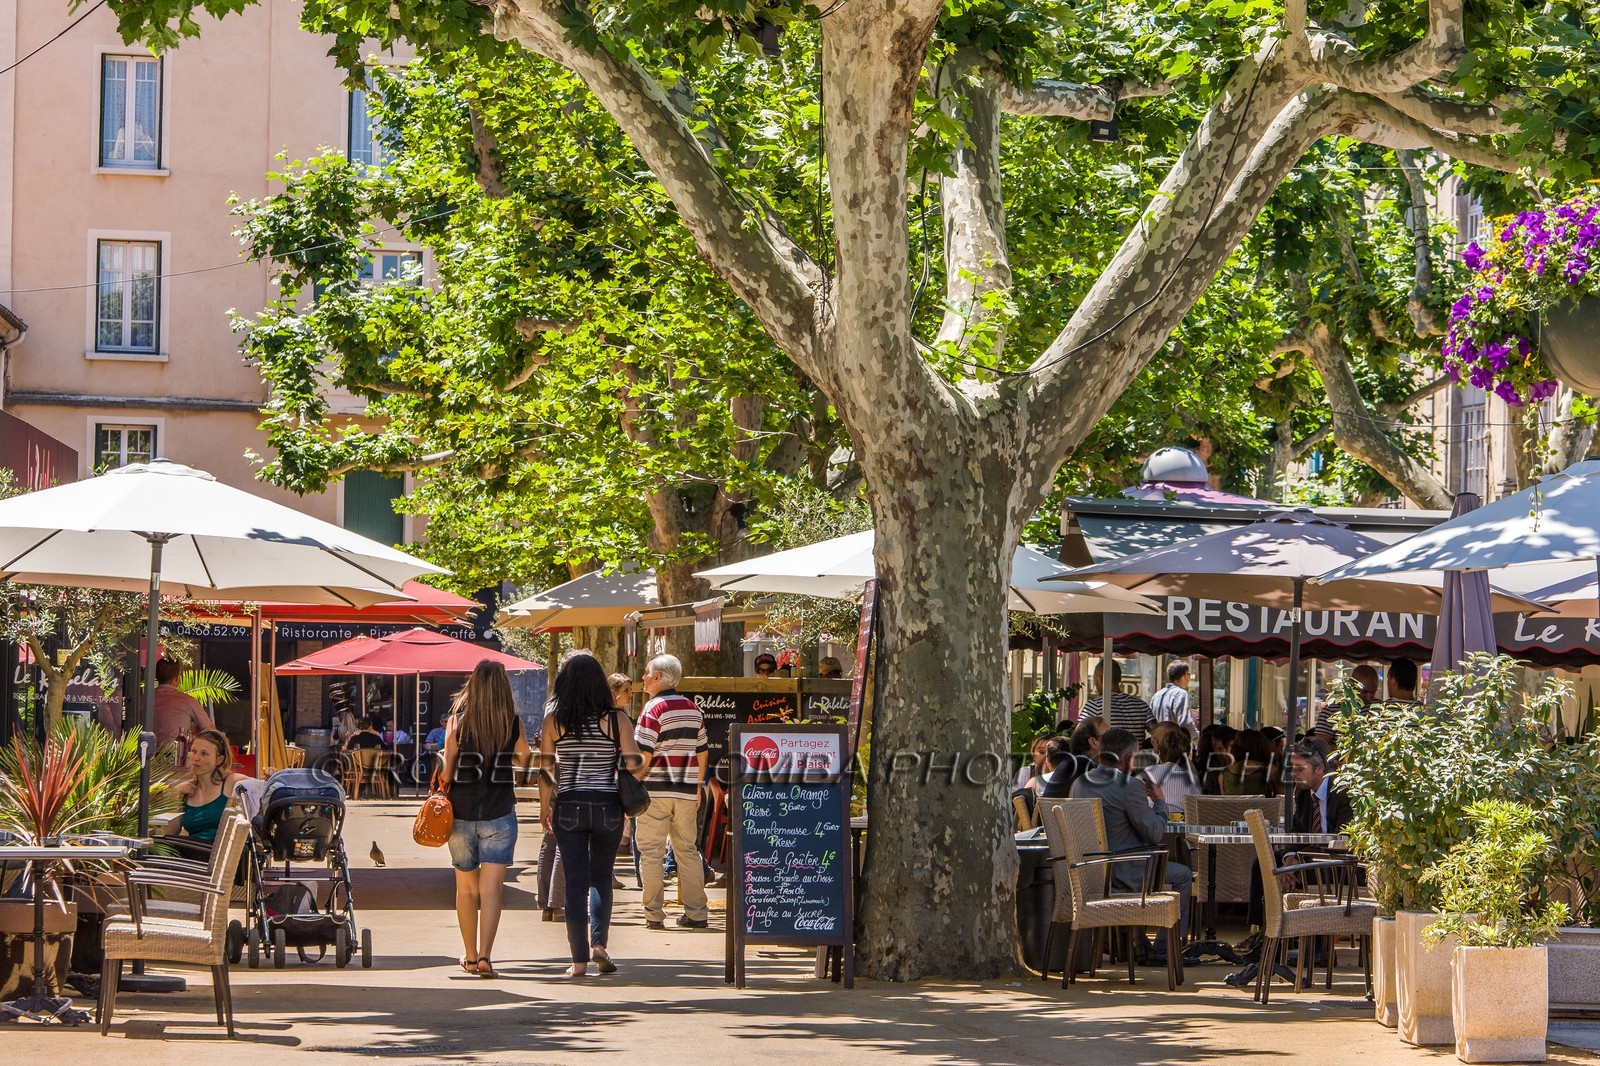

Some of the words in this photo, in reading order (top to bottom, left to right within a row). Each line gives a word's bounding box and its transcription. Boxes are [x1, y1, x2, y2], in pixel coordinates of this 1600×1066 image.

[1167, 596, 1440, 640] RESTAURAN
[282, 627, 352, 639] Ristorante
[1514, 613, 1564, 643] Le
[14, 665, 31, 684] Le
[99, 696, 118, 704] TAPAS
[780, 738, 830, 749] Partagez
[796, 750, 837, 758] moment
[797, 760, 832, 768] Plaisir
[776, 791, 788, 800] ou
[790, 785, 829, 809] Orange
[743, 819, 811, 839] Pamplemousse
